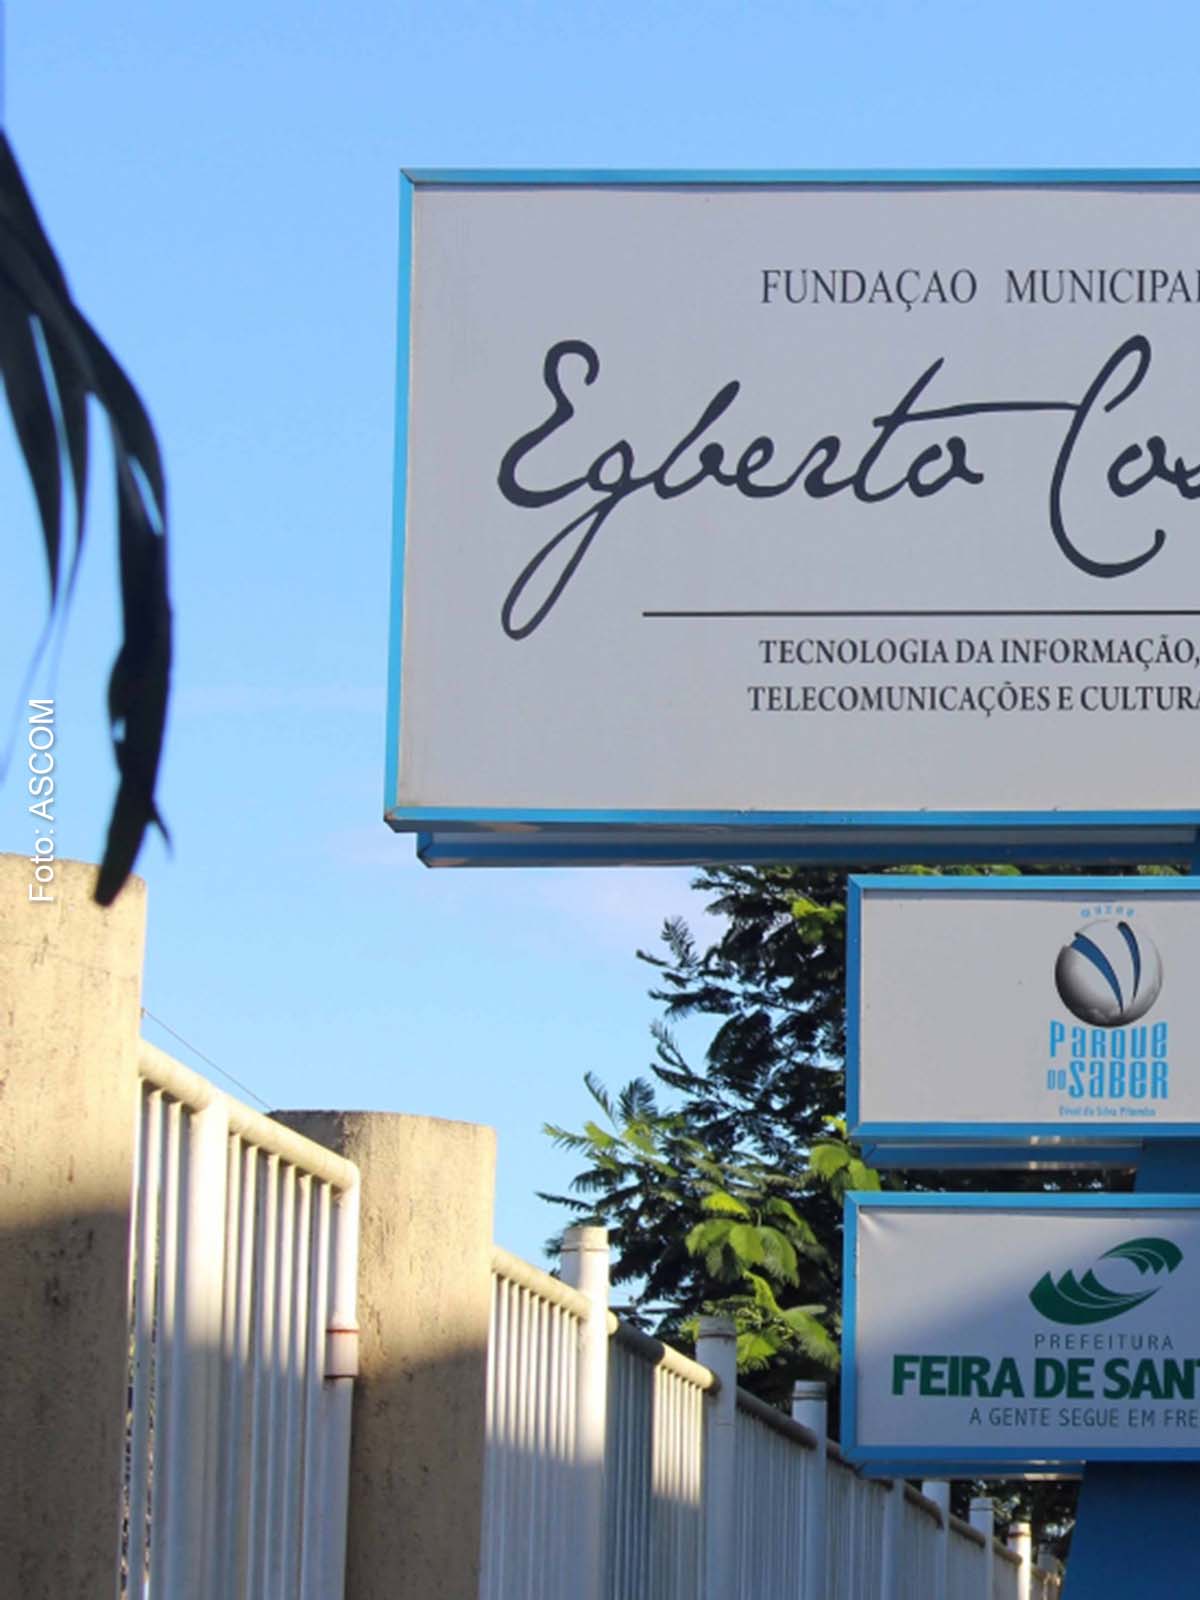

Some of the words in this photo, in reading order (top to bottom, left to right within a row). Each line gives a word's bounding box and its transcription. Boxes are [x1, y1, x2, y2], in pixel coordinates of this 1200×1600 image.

[498, 339, 1079, 640] Egberto
[759, 638, 949, 664] TECNOLOGIA
[955, 639, 995, 664] DA
[1000, 634, 1200, 671] INFORMAÇÃO,
[747, 681, 1051, 718] TELECOMUNICAÇÕES
[1057, 685, 1074, 711] E
[1034, 1333, 1174, 1351] PREFEITURA
[891, 1354, 1025, 1399] FEIRA
[1033, 1357, 1095, 1400] DE
[969, 1407, 982, 1426] A
[988, 1407, 1051, 1427] GENTE
[1058, 1407, 1119, 1428] SEGUE
[1127, 1407, 1156, 1429] EM
